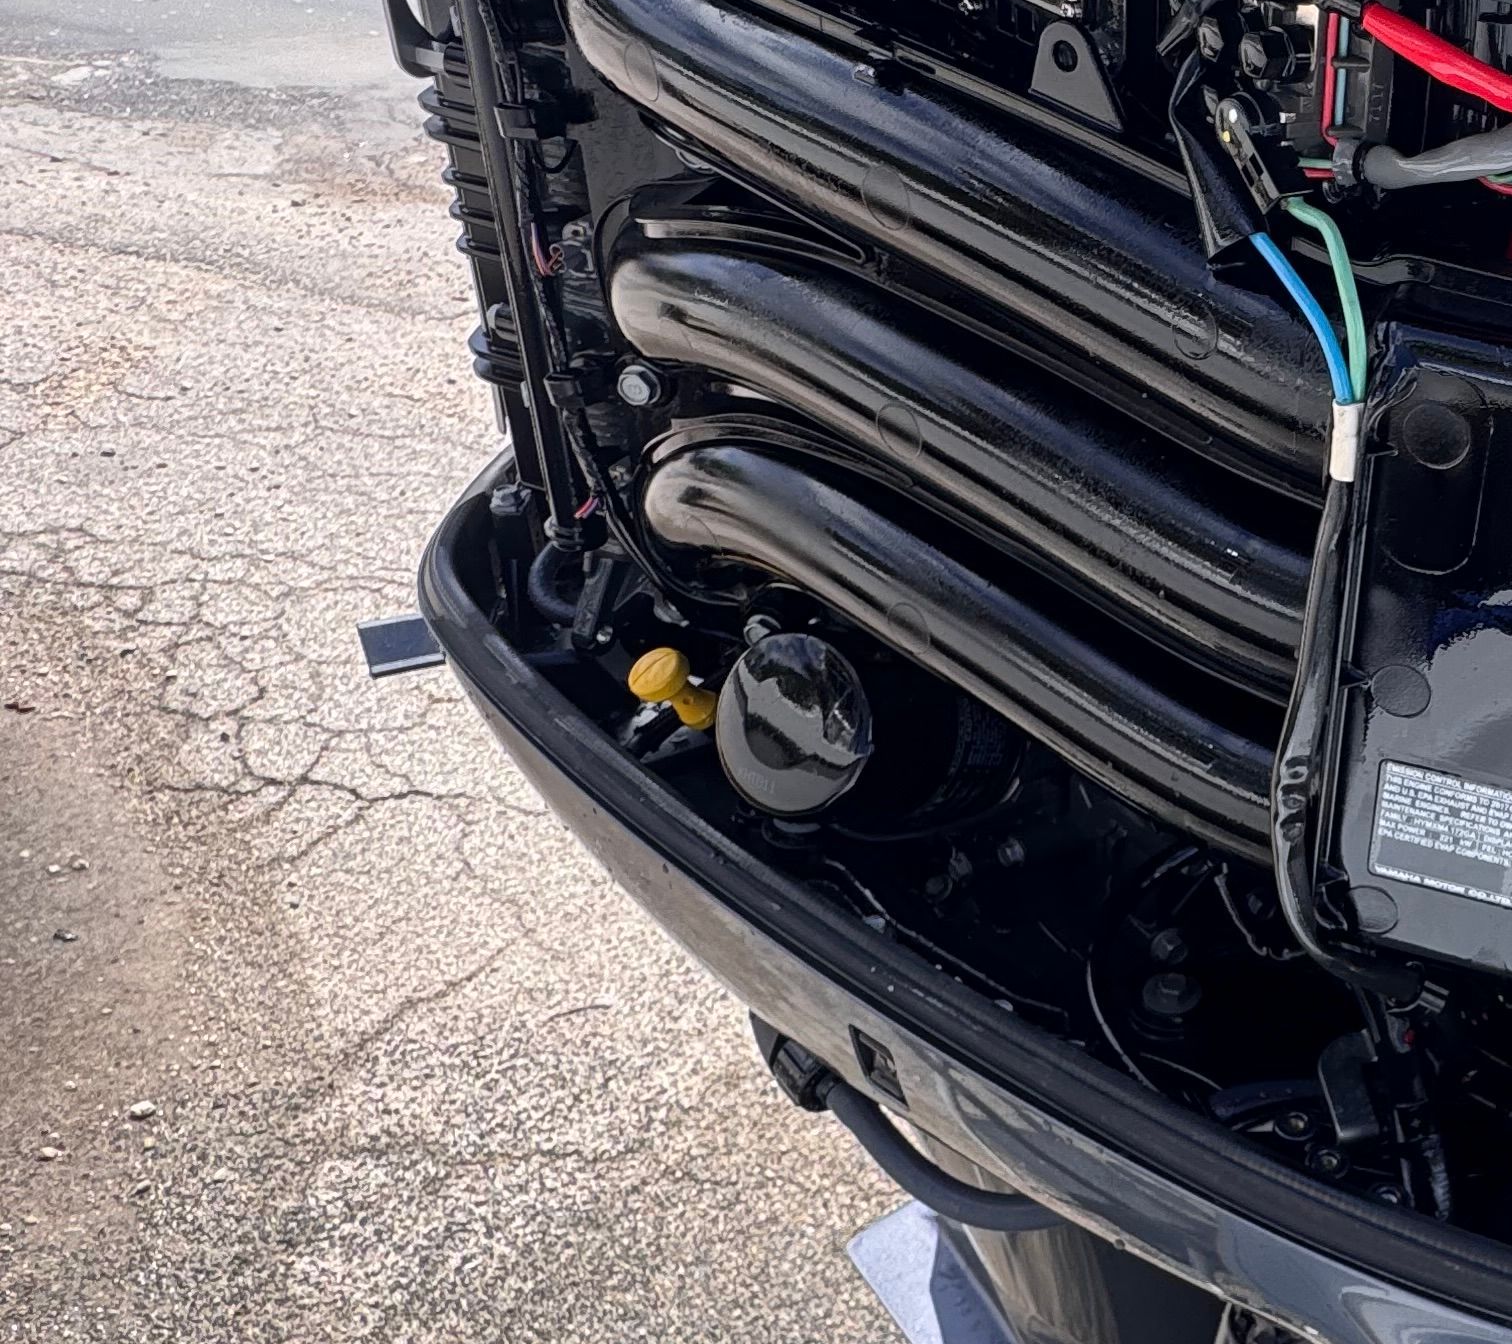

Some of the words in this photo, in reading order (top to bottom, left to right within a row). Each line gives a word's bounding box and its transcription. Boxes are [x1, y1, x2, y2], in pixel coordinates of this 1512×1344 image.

[1424, 772, 1461, 788] CONTROL
[1383, 782, 1400, 793] AND
[1417, 790, 1433, 801] EPA
[1433, 794, 1469, 810] EXHAUST
[1470, 803, 1487, 815] AND
[1403, 778, 1432, 792] ENGINE
[1433, 785, 1477, 803] CONFORMS
[1381, 799, 1435, 819] MAINTENANCE
[1439, 813, 1501, 836] SPECIFICATIONS
[1459, 809, 1486, 824] REFER
[1394, 831, 1433, 847] CERTIFIED
[1396, 822, 1425, 836] POWER
[1374, 864, 1421, 884] YAMAHA
[1422, 877, 1465, 895] MOTOR
